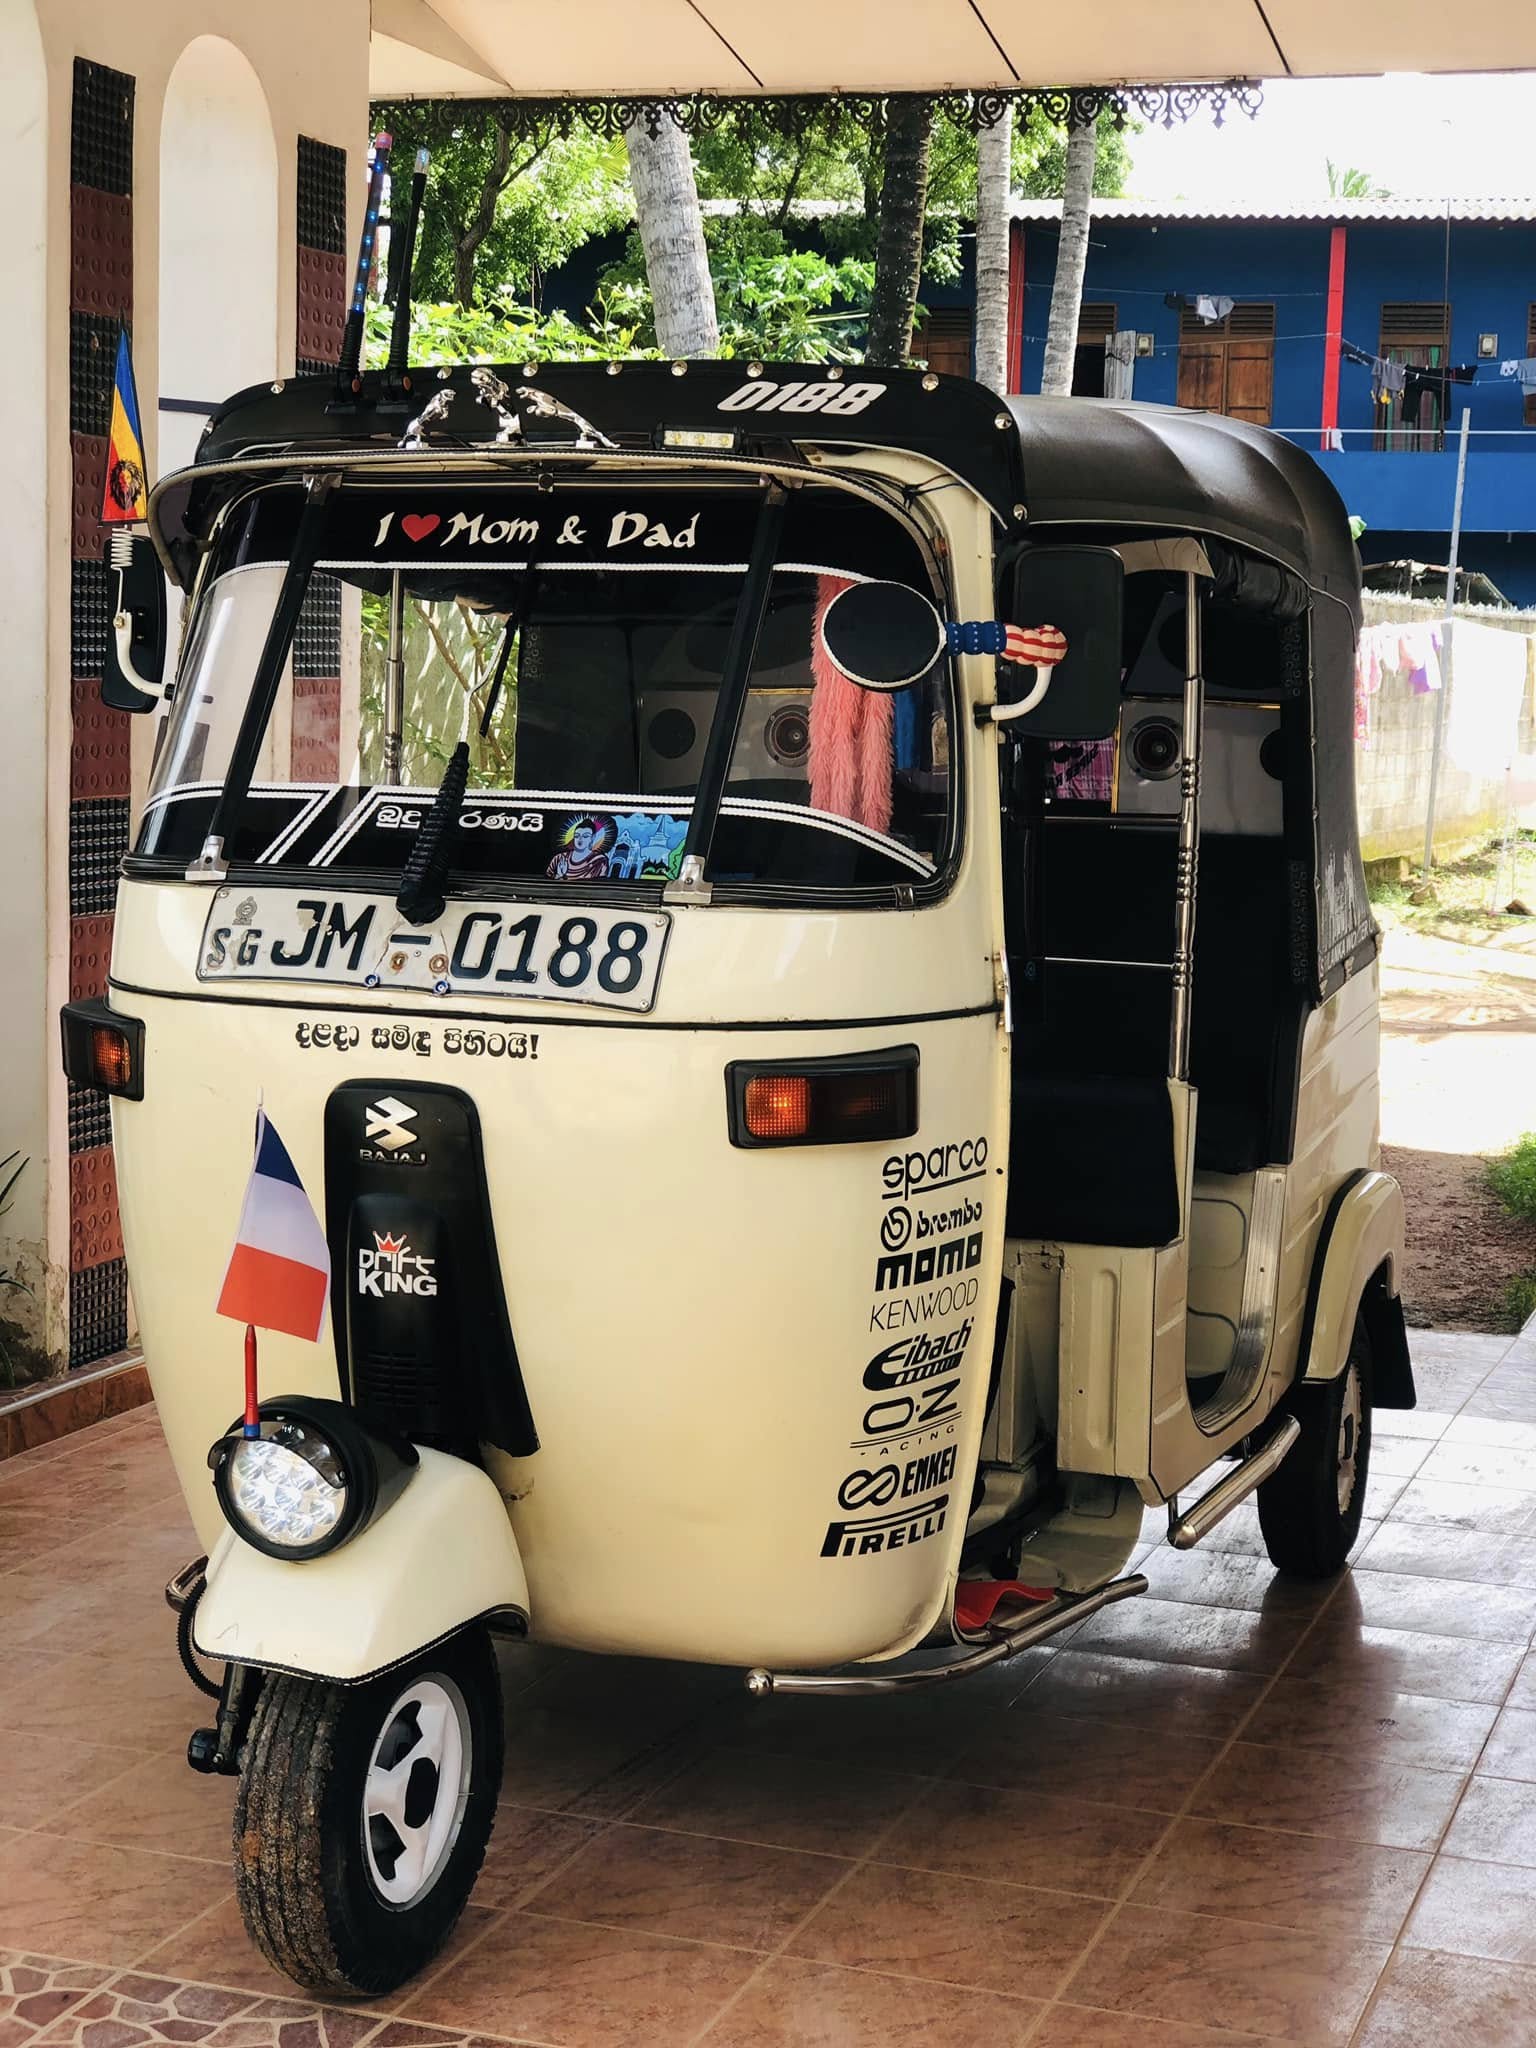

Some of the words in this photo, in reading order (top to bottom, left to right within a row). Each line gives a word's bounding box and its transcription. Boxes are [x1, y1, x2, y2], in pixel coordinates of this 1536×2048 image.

[717, 381, 887, 415] 0188
[374, 511, 395, 547] I
[440, 511, 540, 547] Mom
[556, 515, 588, 544] &
[607, 511, 701, 548] Dad
[376, 805, 422, 829] බුදු
[458, 810, 544, 833] රණයි
[295, 1022, 360, 1052] දළදා
[359, 1148, 428, 1165] BAJAJ
[882, 1136, 989, 1201] sparco
[916, 1197, 984, 1240] brembo
[358, 1267, 438, 1298] KING
[869, 1277, 980, 1333] KENWOOD
[862, 1316, 975, 1392] Eibach
[860, 1424, 955, 1457] ACING
[901, 1443, 959, 1499] ENKEI
[819, 1493, 950, 1558] PIRELLI
